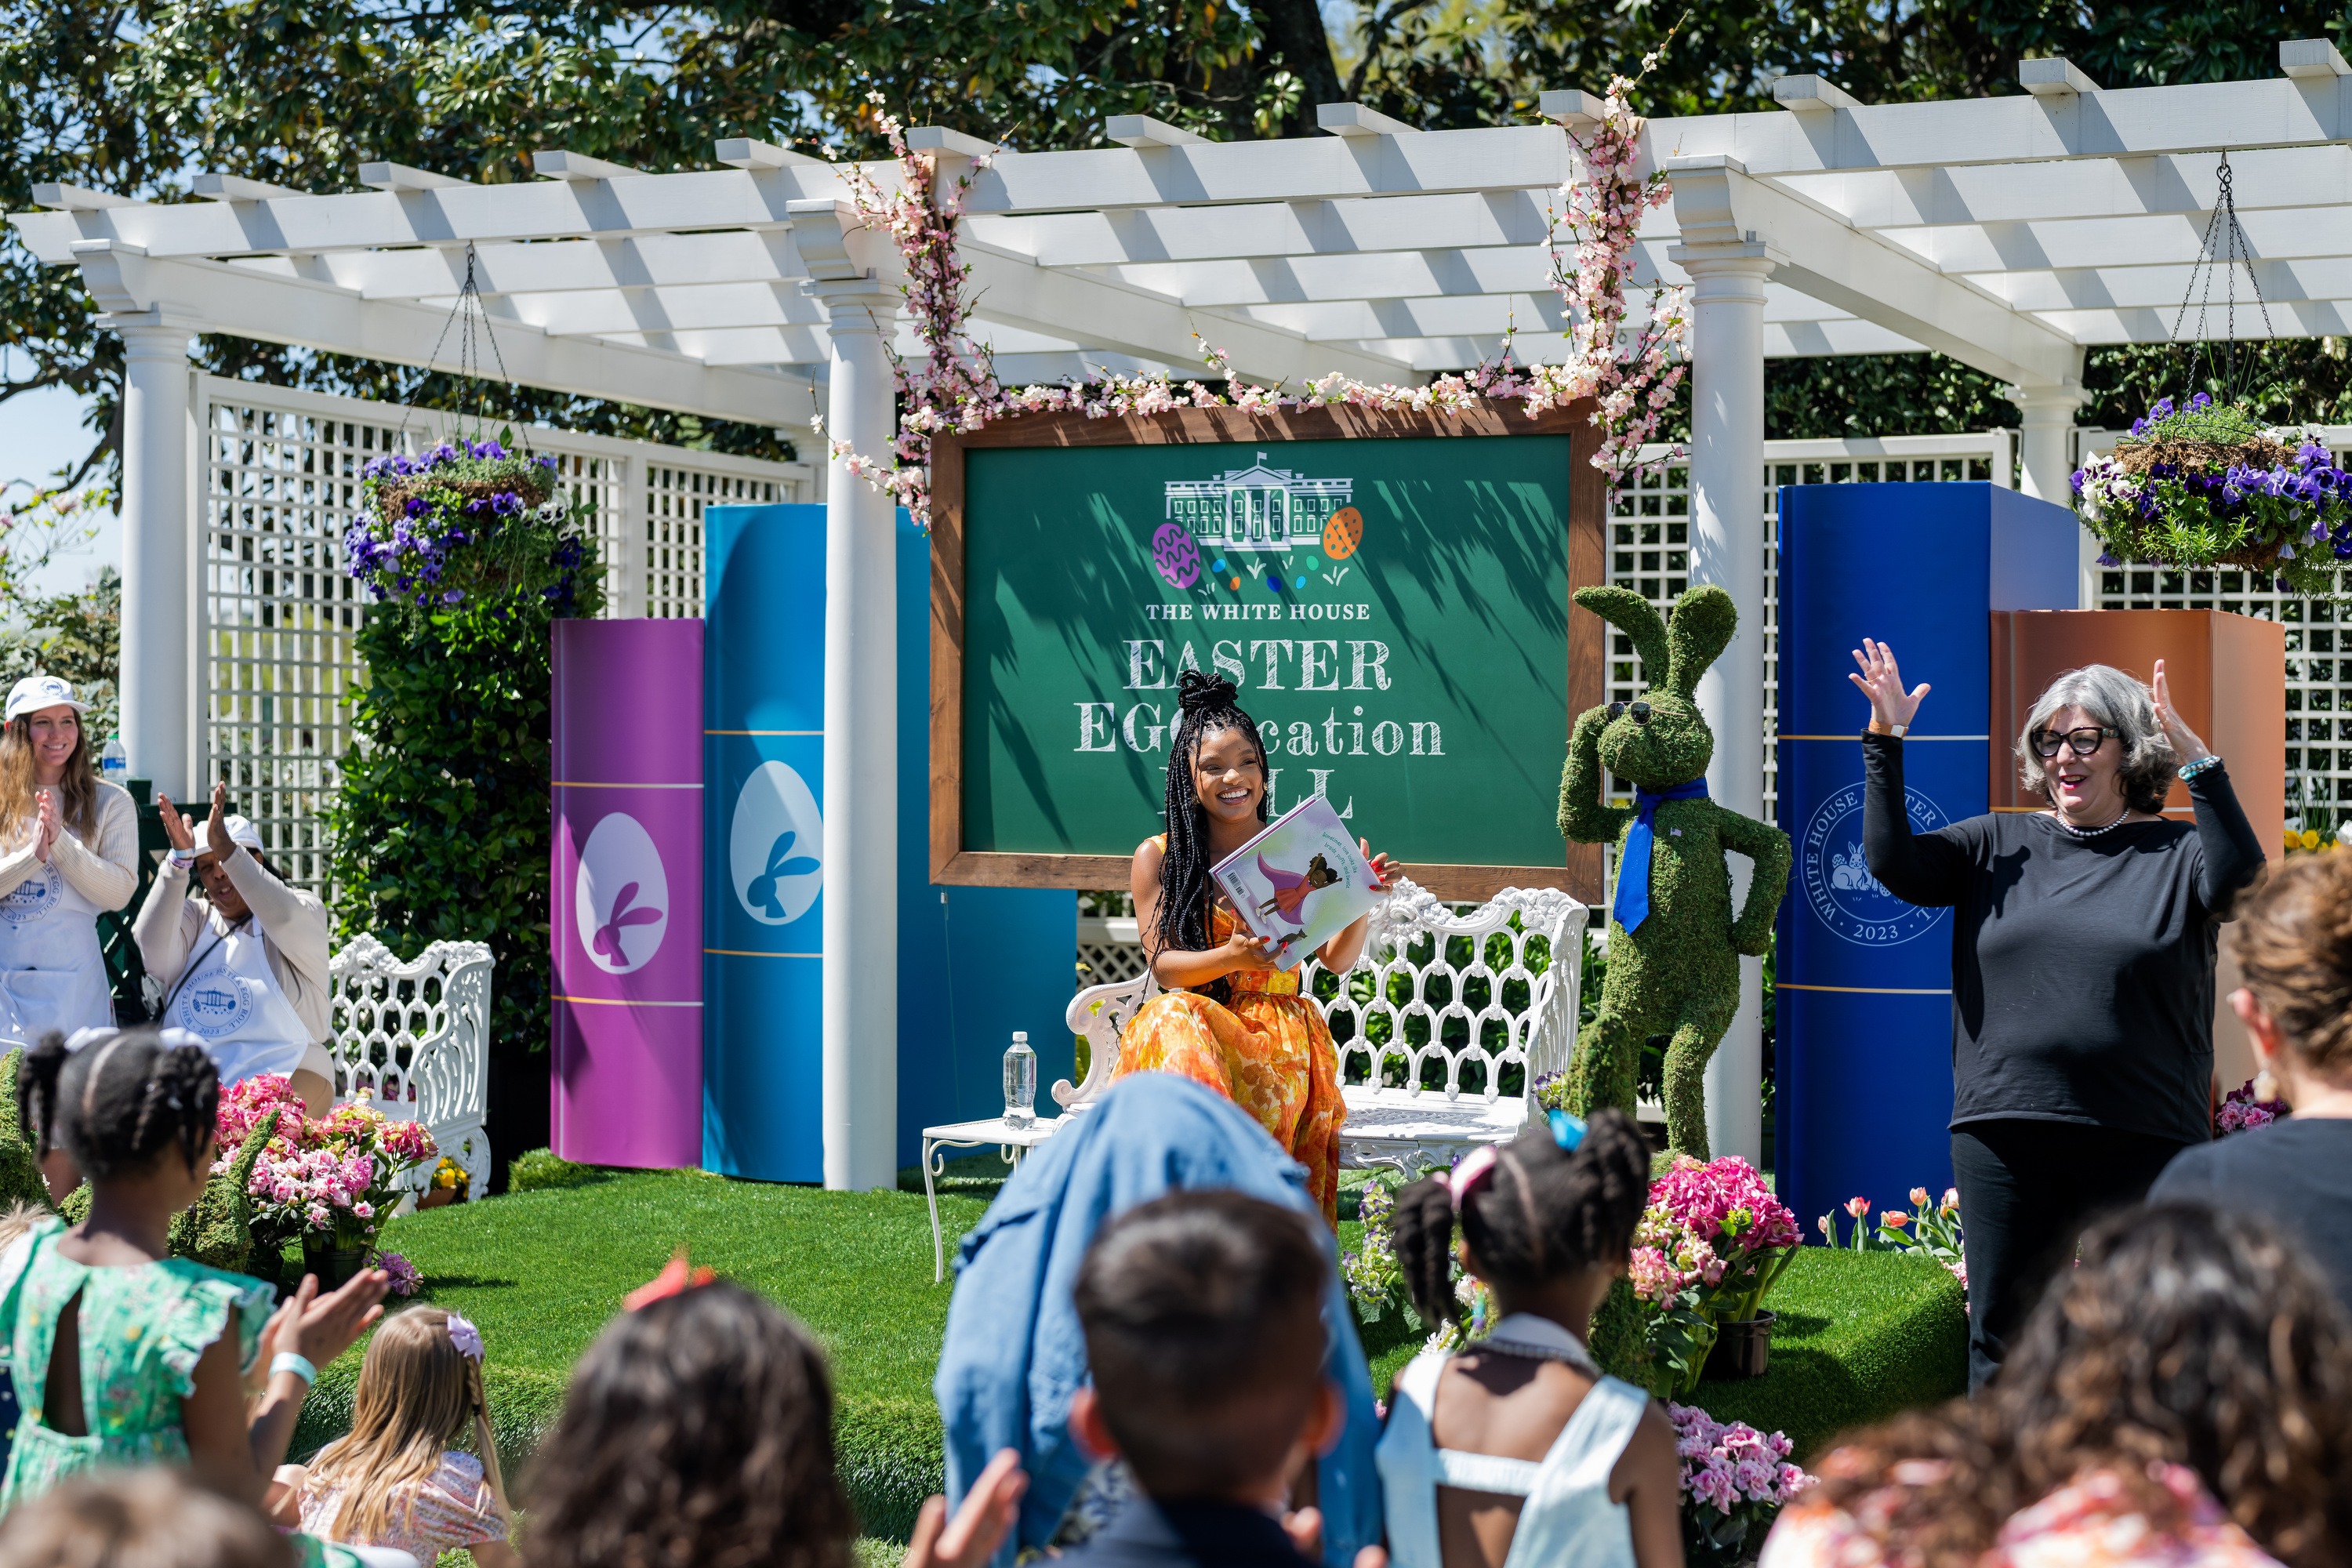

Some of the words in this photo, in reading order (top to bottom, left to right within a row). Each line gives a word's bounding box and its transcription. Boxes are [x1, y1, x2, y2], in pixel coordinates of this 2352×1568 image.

[1145, 604, 1193, 620] THE
[1201, 604, 1282, 620] WHITE
[1290, 604, 1370, 620] HOUSE
[1123, 639, 1392, 691] EASTER
[1073, 702, 1446, 756] EGcation
[1809, 791, 1858, 848] HOUSE
[1806, 853, 1836, 921] WHITE
[1853, 924, 1898, 940] 2023
[241, 987, 249, 1006] EGG
